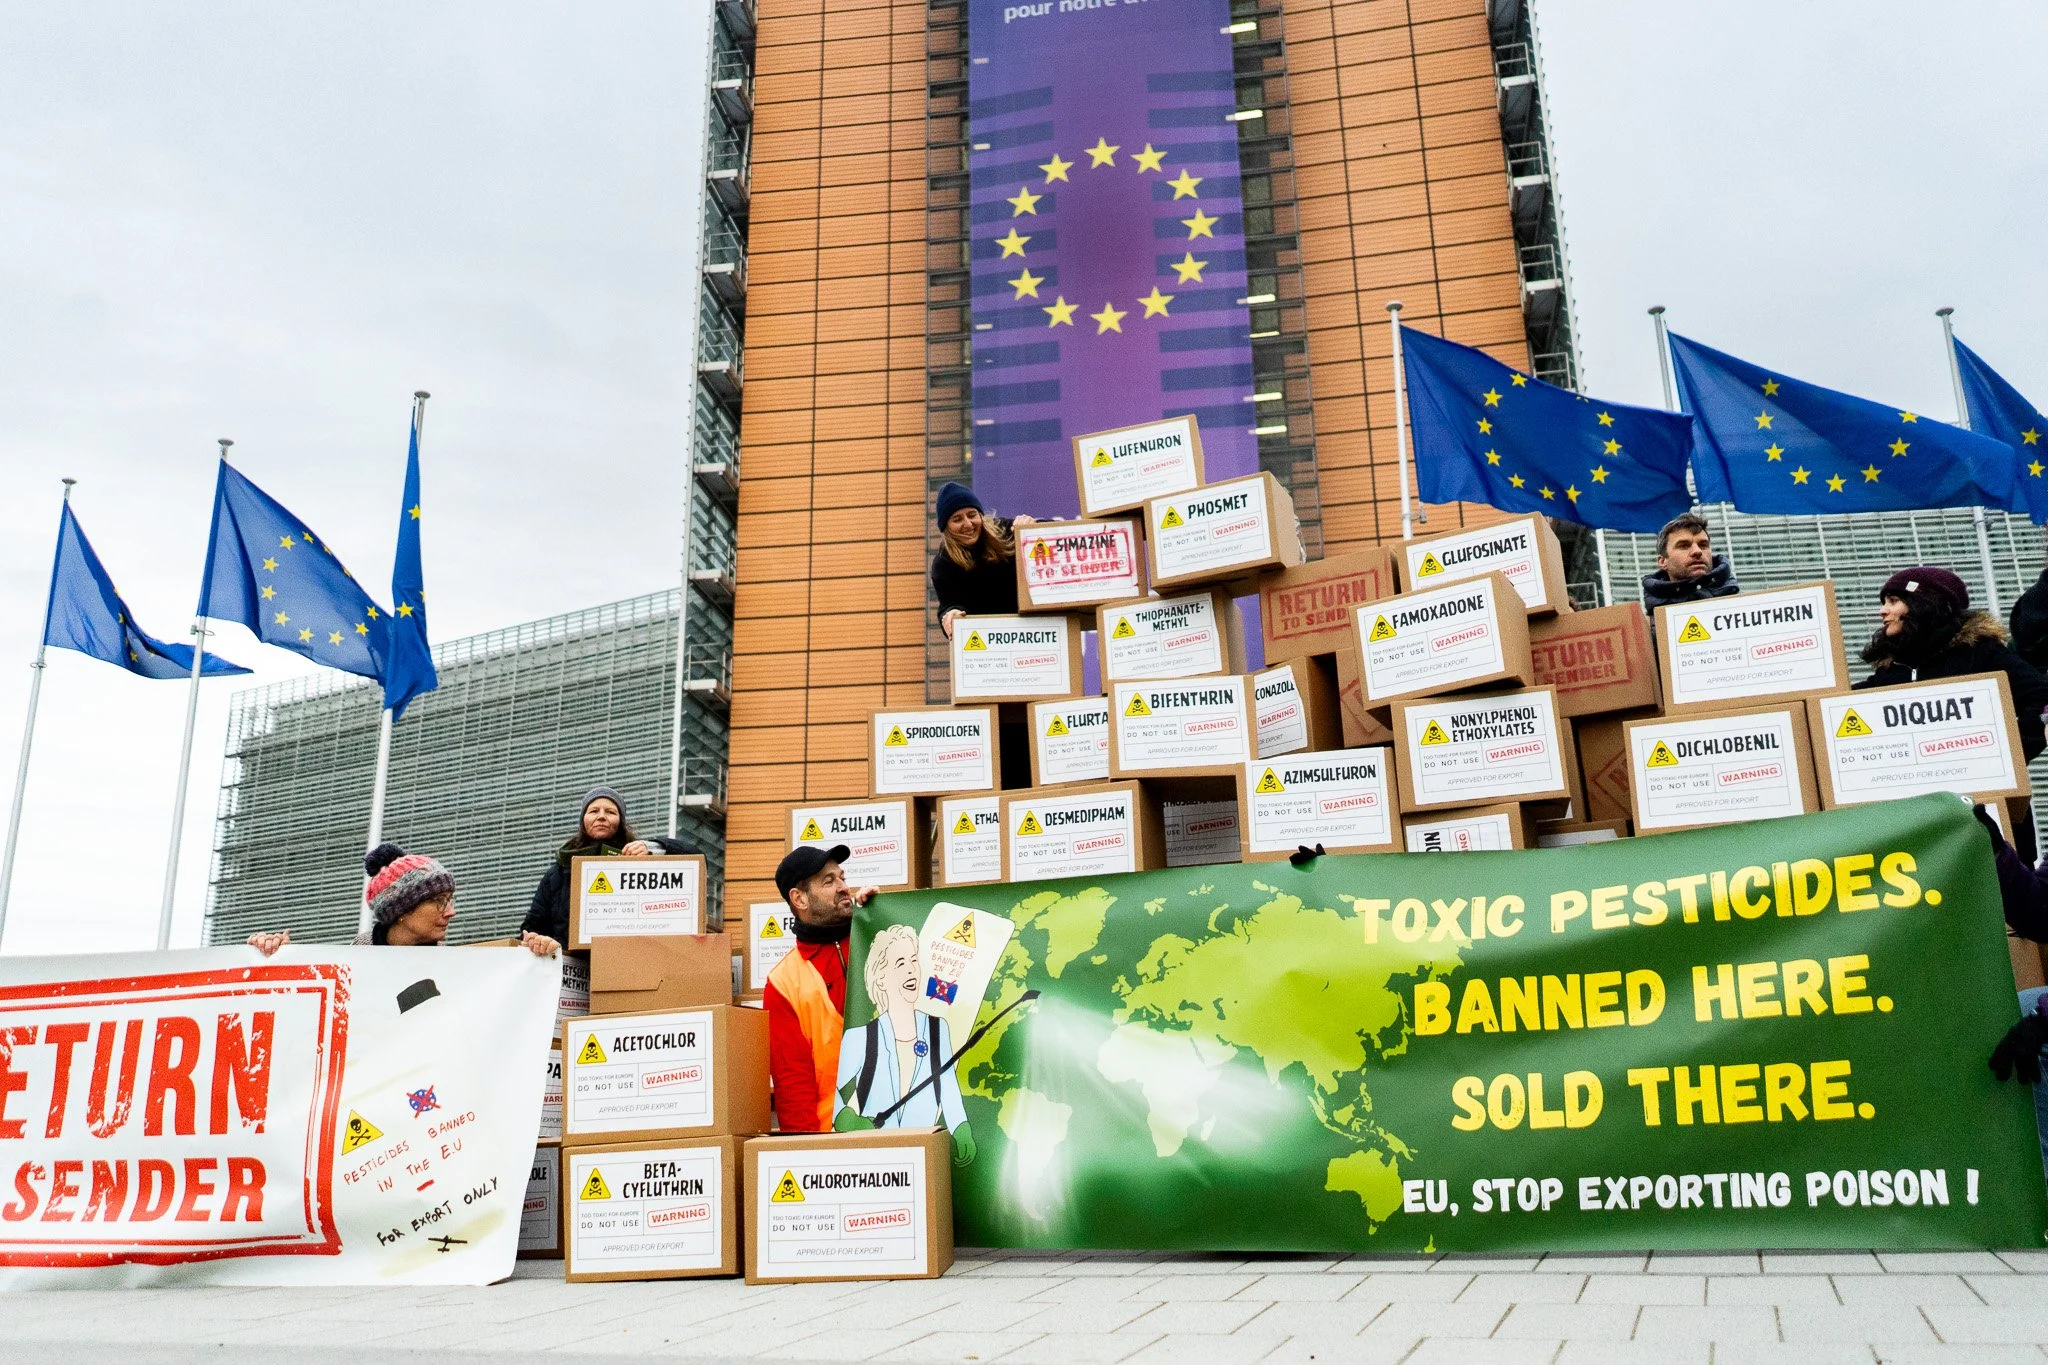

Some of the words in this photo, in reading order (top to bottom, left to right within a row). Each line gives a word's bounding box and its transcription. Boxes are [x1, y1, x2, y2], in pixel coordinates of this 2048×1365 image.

[1004, 2, 1053, 23] pour
[1113, 435, 1181, 458] LUFENURON
[1143, 459, 1179, 473] WARNING
[1188, 494, 1248, 519] PHOSMET
[1215, 520, 1256, 535] WARNING
[1056, 535, 1116, 552] SIMAZINE
[1442, 534, 1527, 566] GLUFOSINATE
[1279, 579, 1366, 616] RETURN
[1136, 603, 1205, 622] THIOPHANATE-
[1282, 617, 1300, 630] TO
[1306, 608, 1346, 626] SEND
[1393, 595, 1484, 630] FAMOXADONE
[1714, 604, 1813, 631] CYFLUTHRIN
[1152, 618, 1188, 632] METHYL
[988, 631, 1057, 644] PROPARGITE
[1167, 635, 1207, 648] WARNING
[1435, 627, 1484, 647] WARNING
[1389, 652, 1404, 660] NOT
[1410, 647, 1425, 655] USE
[1755, 638, 1814, 655] WARNING
[1017, 656, 1055, 665] WARNING
[1543, 664, 1616, 684] SENDER
[1706, 674, 1744, 683] APPROVED
[1763, 668, 1793, 677] EXPORT
[1151, 689, 1234, 709] BIFENTHRIN
[1261, 708, 1294, 725] WARNING
[1451, 707, 1538, 728] NONYLPHENOL
[1883, 696, 1974, 728] DIQUAT
[906, 725, 980, 739] SPIRODICLOFEN
[1188, 720, 1235, 732] WARNING
[1452, 722, 1535, 743] ETHOXYLATES
[1490, 744, 1540, 758] WARNING
[1677, 733, 1779, 758] DICHLOBENIL
[1924, 734, 1989, 752] WARNING
[938, 751, 977, 760] WARNING
[1890, 750, 1910, 758] USE
[1284, 764, 1376, 785] AZIMSULFURON
[1722, 767, 1778, 782] WARNING
[1871, 772, 1914, 782] APPROVED
[1935, 767, 1968, 776] EXPORT
[1323, 796, 1374, 809] WARNING
[830, 815, 886, 833] ASULAM
[1045, 806, 1125, 827] DESMEDIPHAM
[1190, 820, 1232, 831] WARNING
[855, 843, 895, 854] WARNING
[1076, 837, 1120, 850] WARNING
[620, 872, 683, 889] FERBAM
[644, 902, 686, 910] WARNING
[1353, 895, 1524, 946] TOXIC
[1551, 852, 1943, 935] PESTICIDES.
[1414, 968, 1666, 1036] BANNED
[1692, 954, 1894, 1023] HERE.
[613, 1032, 696, 1053] ACETOCHLOR
[0, 1011, 275, 1138] ETURN
[646, 1069, 698, 1084] WARNING
[1450, 1070, 1604, 1132] SOLD
[1627, 1060, 1876, 1127] THERE.
[599, 1105, 634, 1113] APPROVED
[428, 1112, 476, 1138] BANNED
[406, 1158, 430, 1176] THE
[644, 1162, 681, 1180] BETA-
[2, 1156, 267, 1222] SENDER
[623, 1179, 703, 1199] CYFLUTHRIN
[803, 1172, 910, 1190] CHLOROTHALONIL
[464, 1177, 498, 1204] ONLY
[1403, 1179, 1459, 1218] EU,
[1472, 1176, 1564, 1214] STOP
[1579, 1172, 1791, 1211] EXPORTING
[1807, 1168, 1950, 1208] POISON
[1966, 1168, 1979, 1206] !
[651, 1208, 706, 1222] WARNING
[848, 1213, 906, 1226] WARNING
